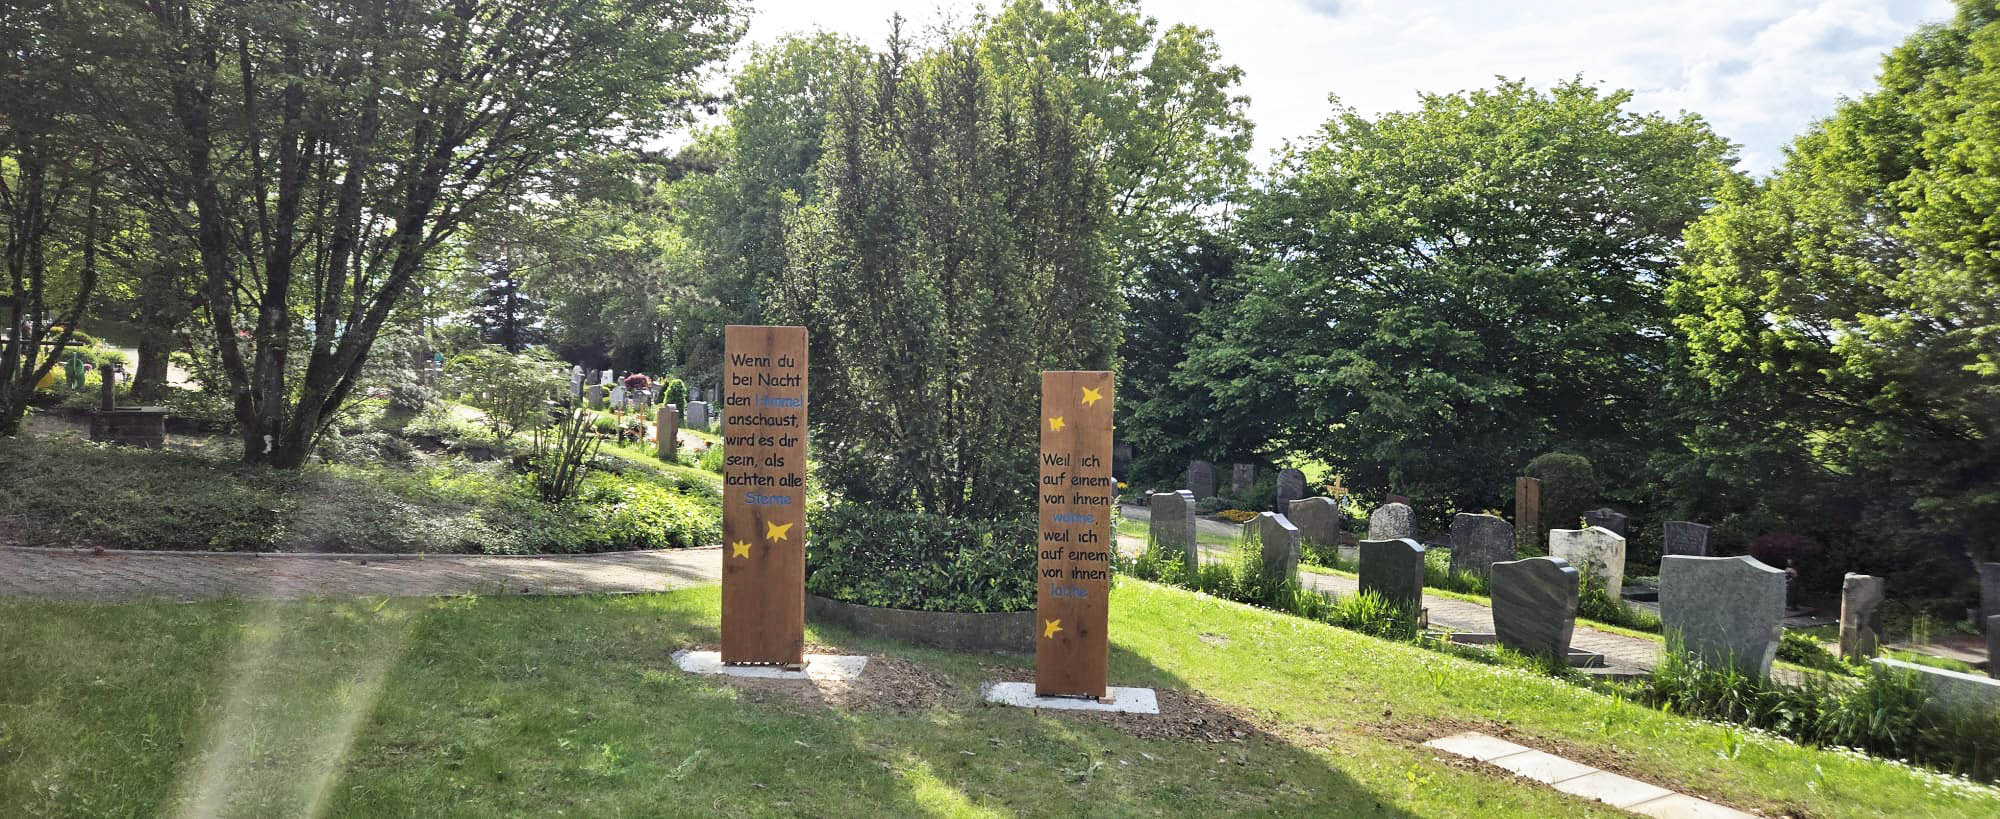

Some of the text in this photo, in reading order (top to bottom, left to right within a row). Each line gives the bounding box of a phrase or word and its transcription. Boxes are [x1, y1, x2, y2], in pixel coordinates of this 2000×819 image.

[731, 353, 795, 368] Wenn du
[732, 372, 802, 387] bei Nacht
[726, 392, 751, 406] den
[728, 413, 799, 428] anschaust,
[726, 432, 798, 448] wird es dir
[726, 453, 785, 469] sein, als
[1043, 453, 1101, 468] Weil ich
[725, 472, 803, 488] lachten alle
[1043, 472, 1110, 487] auf einem
[1043, 492, 1109, 506] von ihnen
[1044, 529, 1098, 544] weil ich
[1041, 546, 1108, 562] auf einem
[1041, 566, 1106, 580] von ihnen
